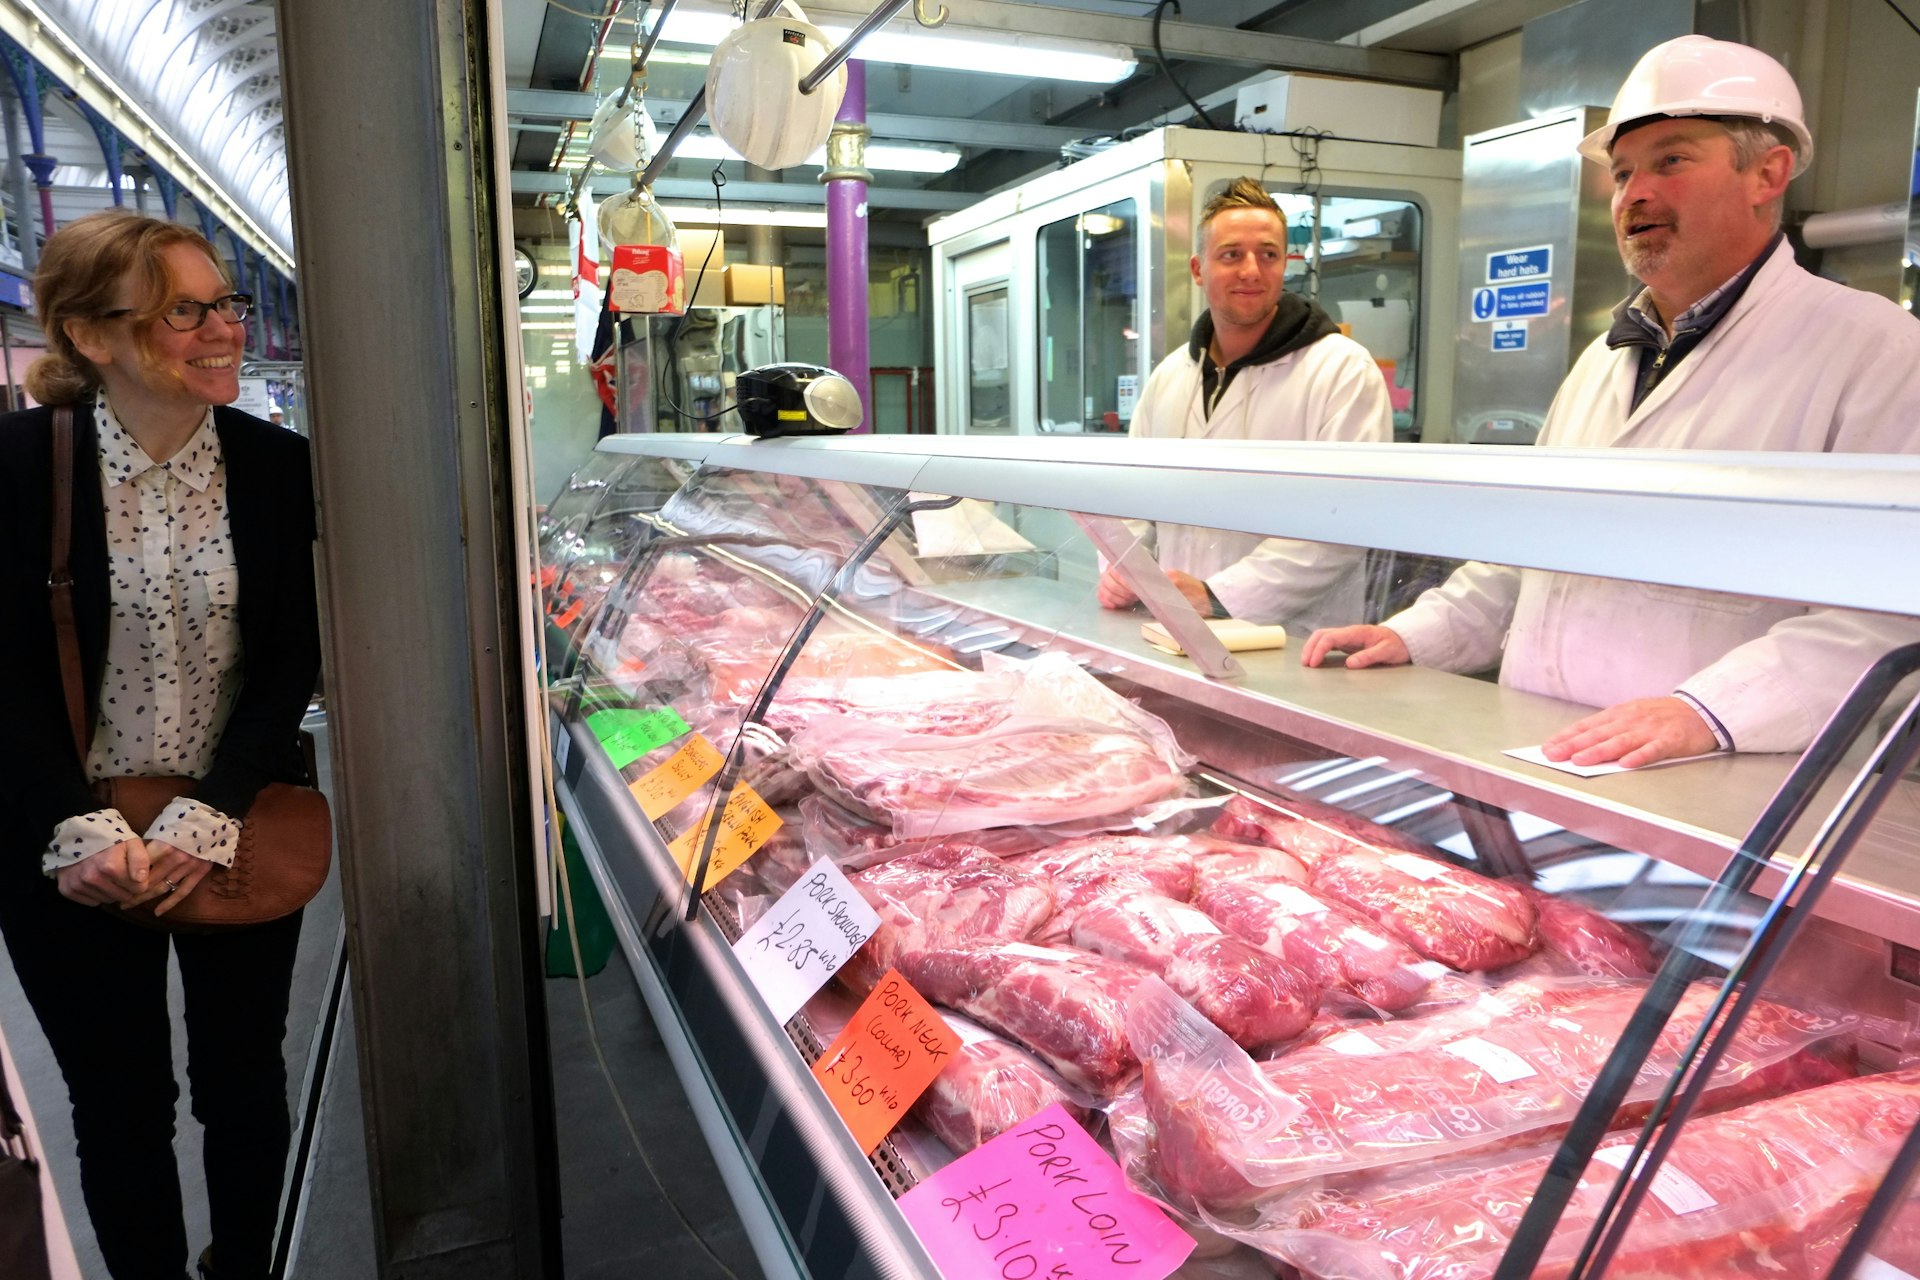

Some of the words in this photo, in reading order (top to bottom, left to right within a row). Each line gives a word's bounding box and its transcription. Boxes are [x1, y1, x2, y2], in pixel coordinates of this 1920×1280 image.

[1497, 266, 1517, 278] hard
[1519, 264, 1539, 275] hats
[1506, 254, 1529, 265] Wear
[728, 792, 766, 825] ENGLISH
[736, 826, 760, 850] PORK
[757, 908, 819, 970] £2.85
[803, 872, 837, 910] PORK
[828, 901, 867, 954] SHOULDER
[866, 1014, 911, 1070] (COLLAR)
[876, 981, 912, 1023] PORK
[909, 1020, 948, 1064] NECK
[825, 1040, 875, 1106] £3.60
[879, 1085, 899, 1110] kilo
[1016, 1124, 1088, 1187] PORK
[1071, 1192, 1142, 1264] LOIN
[941, 1178, 1037, 1280] £3.10
